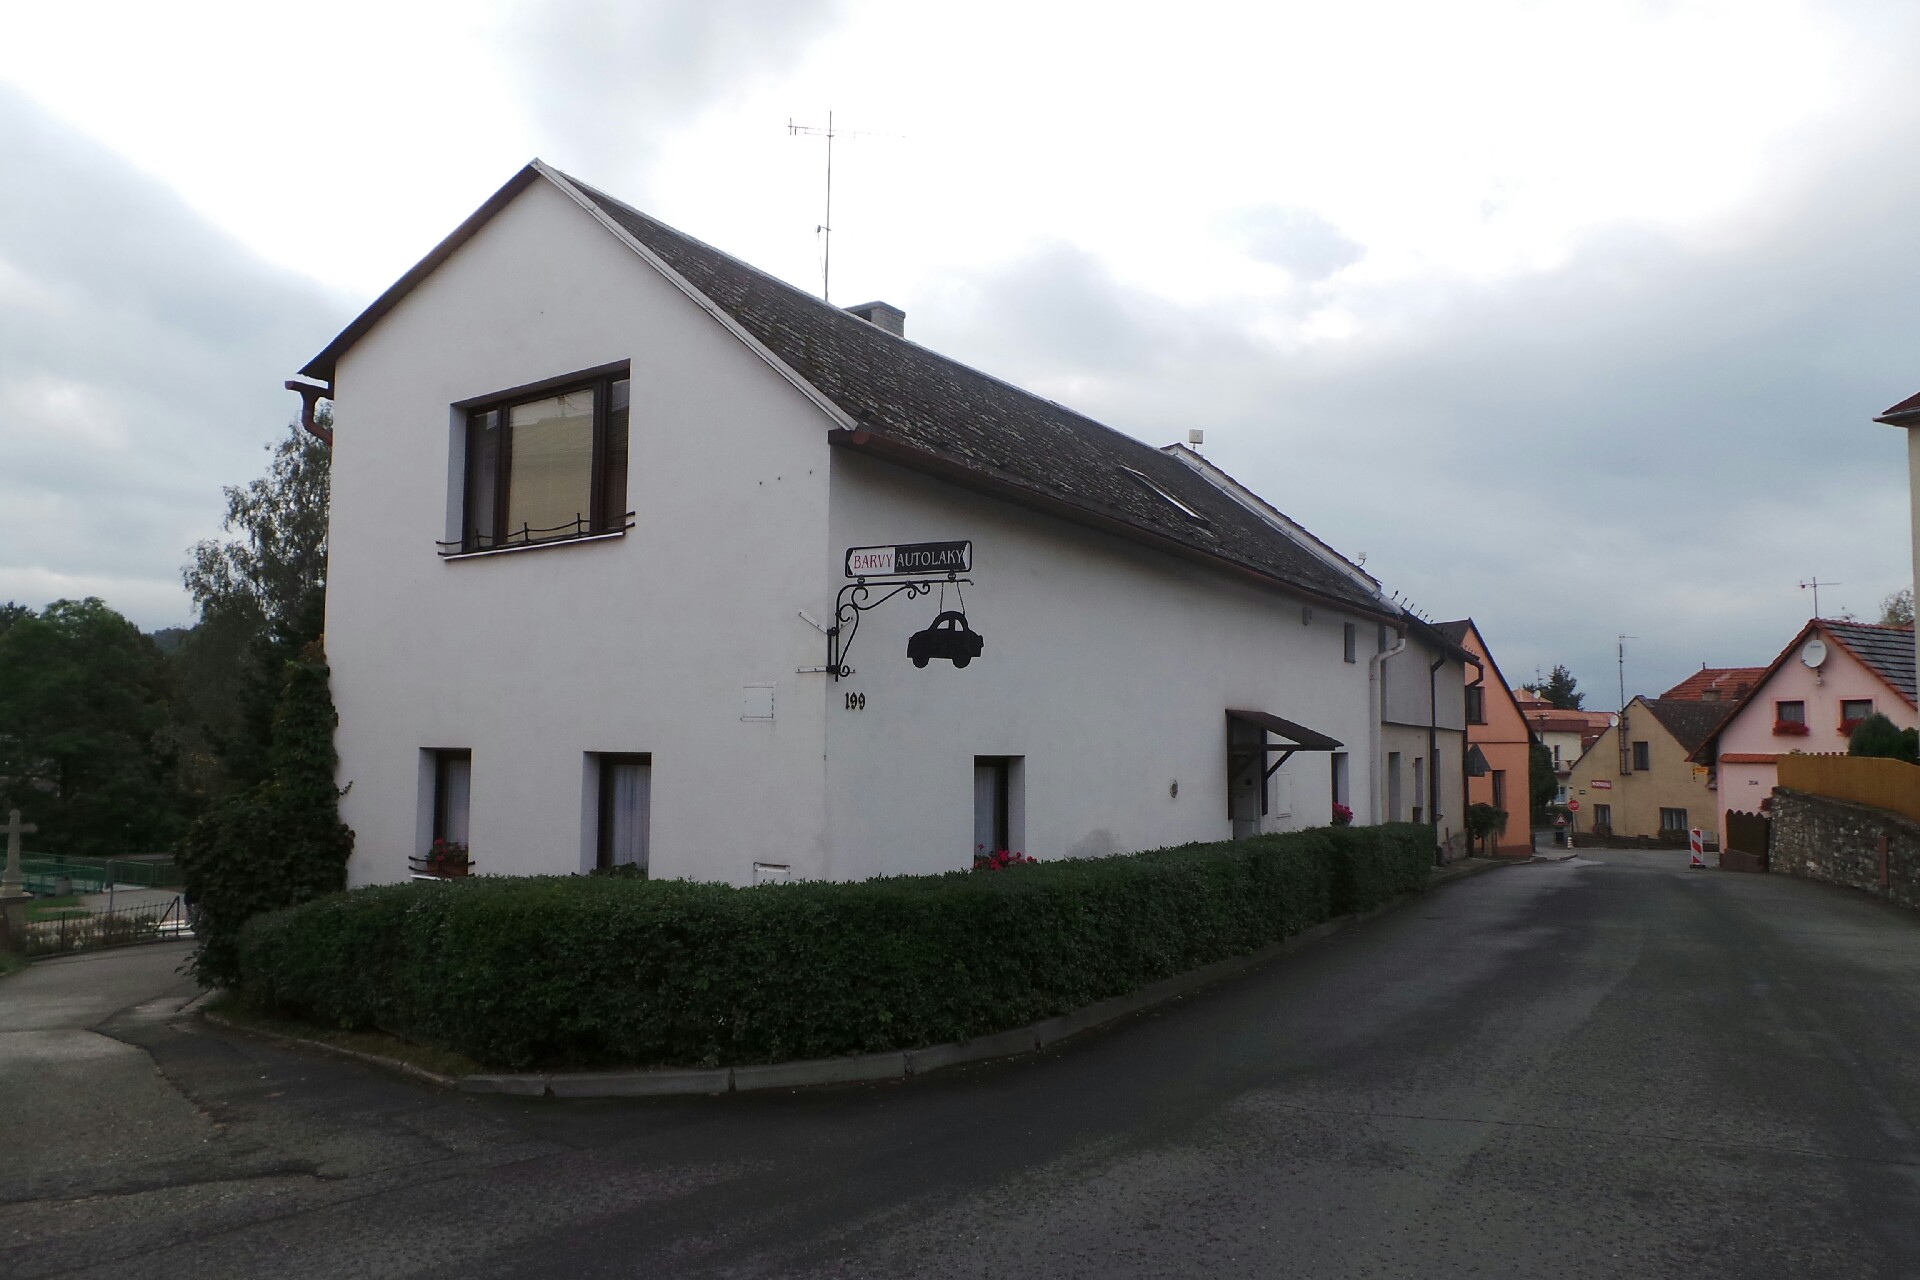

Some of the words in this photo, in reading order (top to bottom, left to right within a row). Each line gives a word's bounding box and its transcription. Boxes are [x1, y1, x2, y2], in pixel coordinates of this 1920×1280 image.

[854, 554, 892, 569] BARVY
[896, 549, 963, 567] AUTOLAKY
[845, 691, 866, 710] 199
